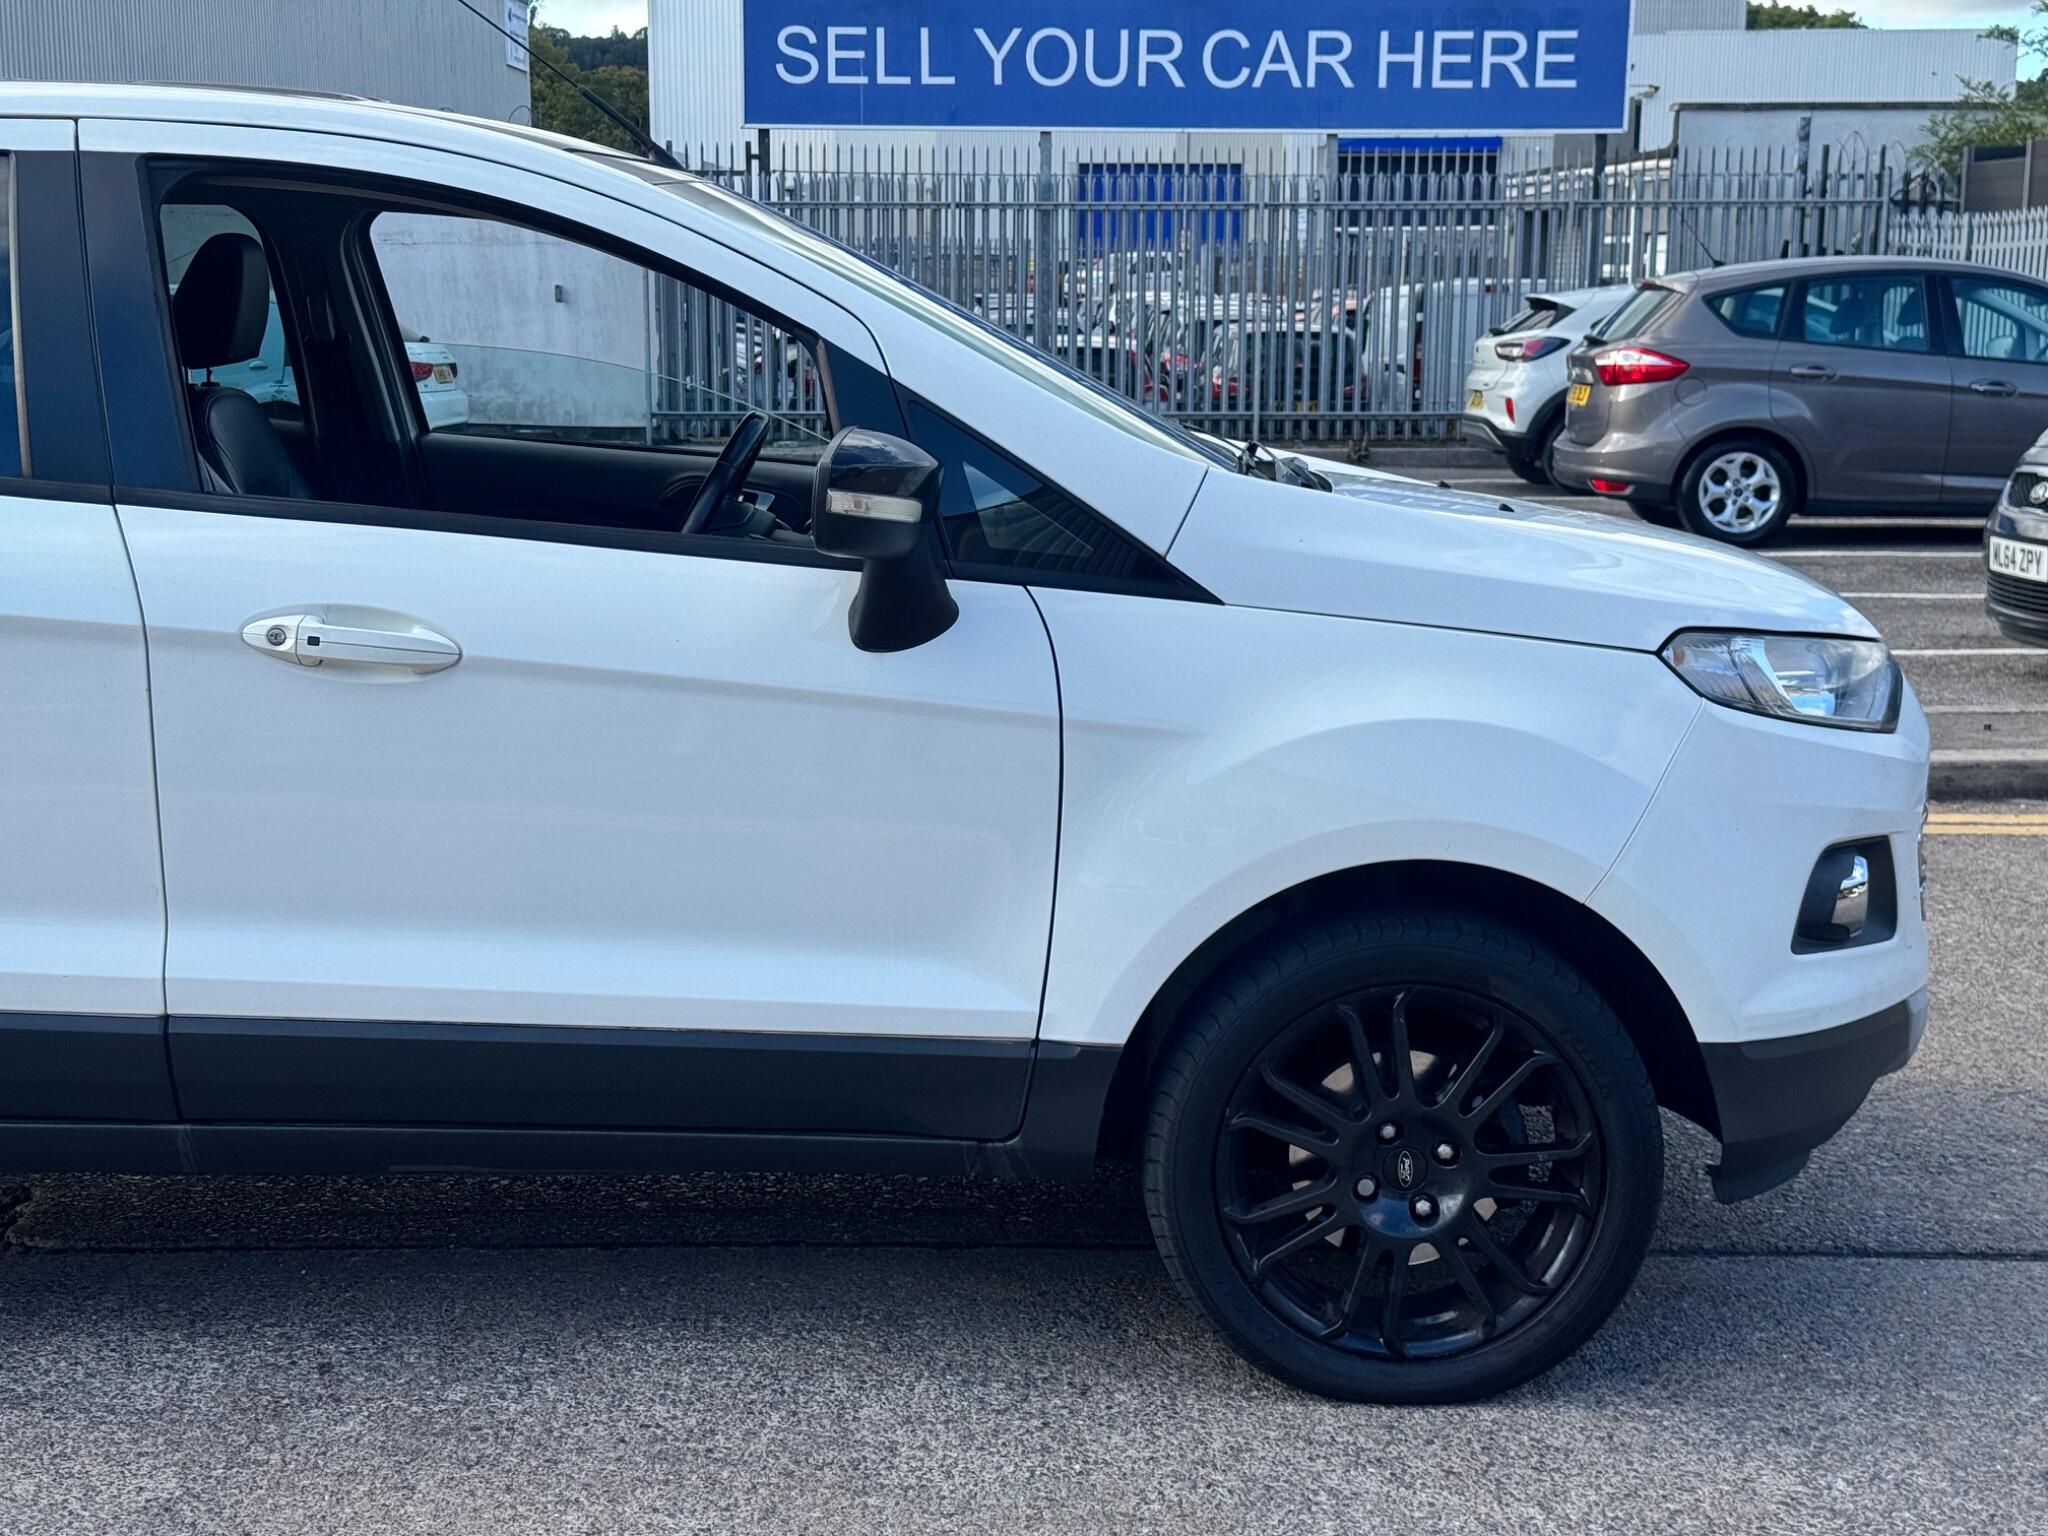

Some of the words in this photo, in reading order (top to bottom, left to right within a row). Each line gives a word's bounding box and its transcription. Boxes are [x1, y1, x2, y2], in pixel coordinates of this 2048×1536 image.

[775, 25, 956, 85] SELL
[973, 27, 1186, 88] YOUR
[1202, 29, 1355, 88] CAR
[1378, 29, 1579, 89] HERE
[2019, 547, 2042, 576] ZPY
